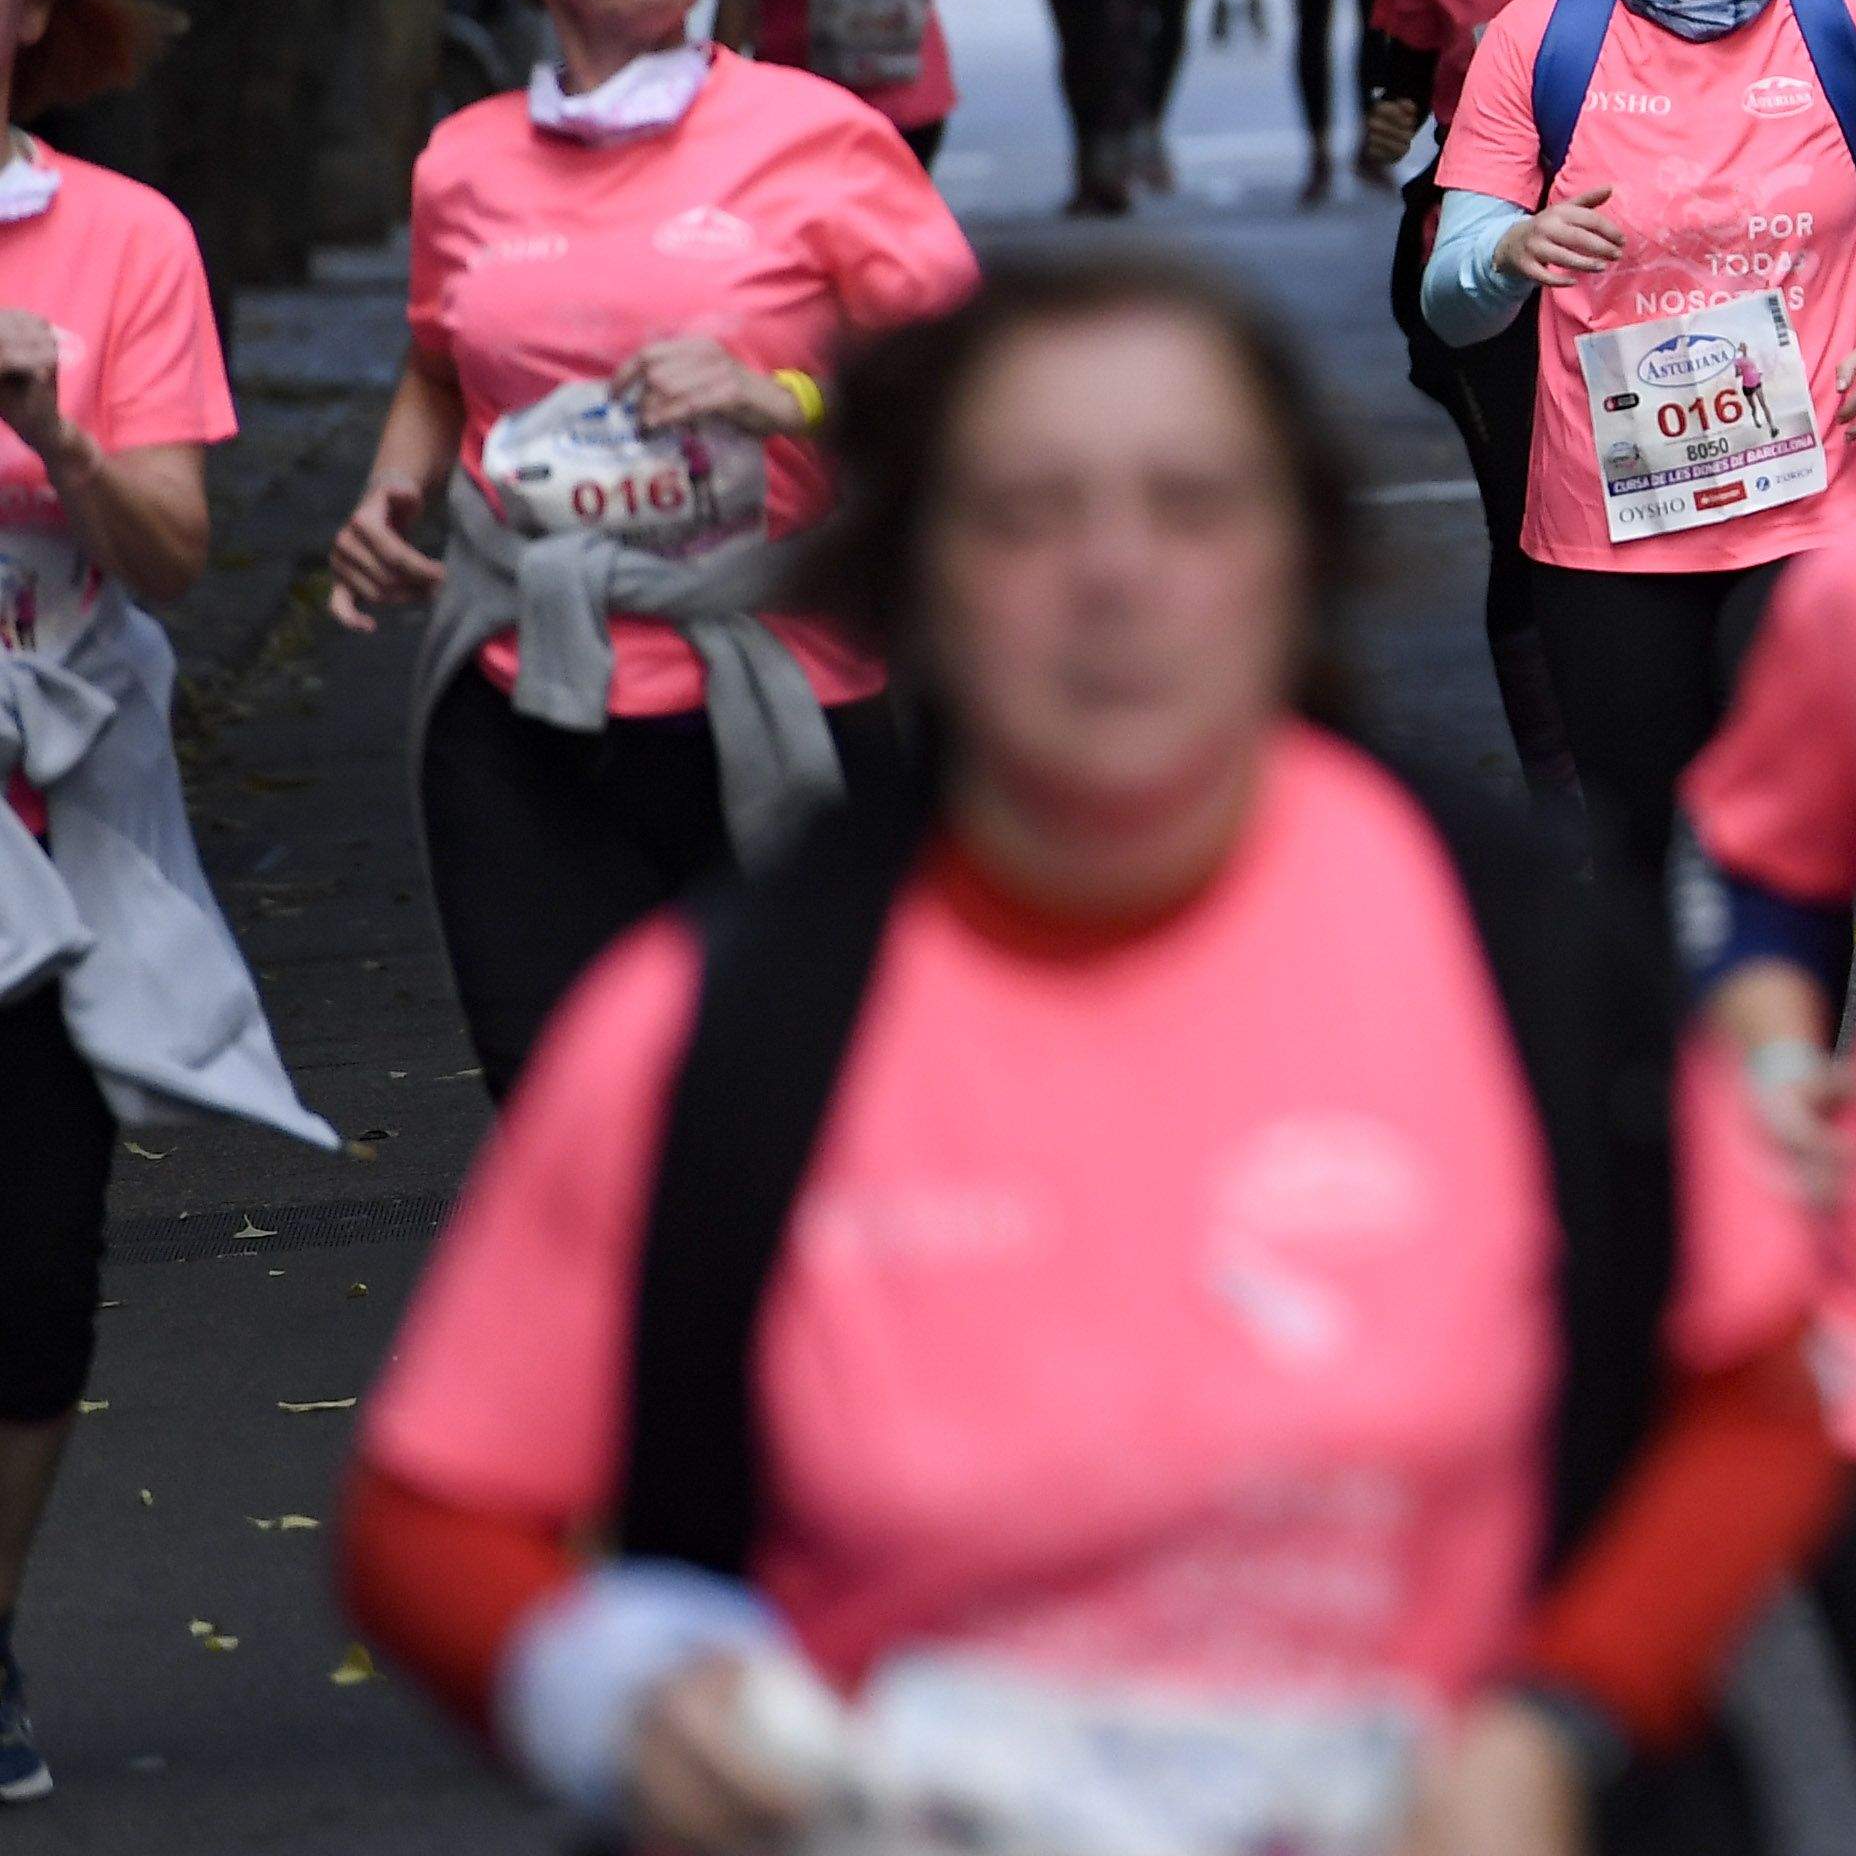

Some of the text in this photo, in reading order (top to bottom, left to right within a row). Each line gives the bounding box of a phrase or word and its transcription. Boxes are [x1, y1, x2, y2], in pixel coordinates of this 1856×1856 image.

[1748, 212, 1814, 240] POR
[1635, 285, 1805, 315] NOSOS
[1647, 350, 1730, 380] ASTURIANA
[1657, 389, 1743, 437] 016
[1686, 437, 1729, 462] 8050
[571, 470, 685, 523] 016
[1619, 497, 1686, 524] OYSHO
